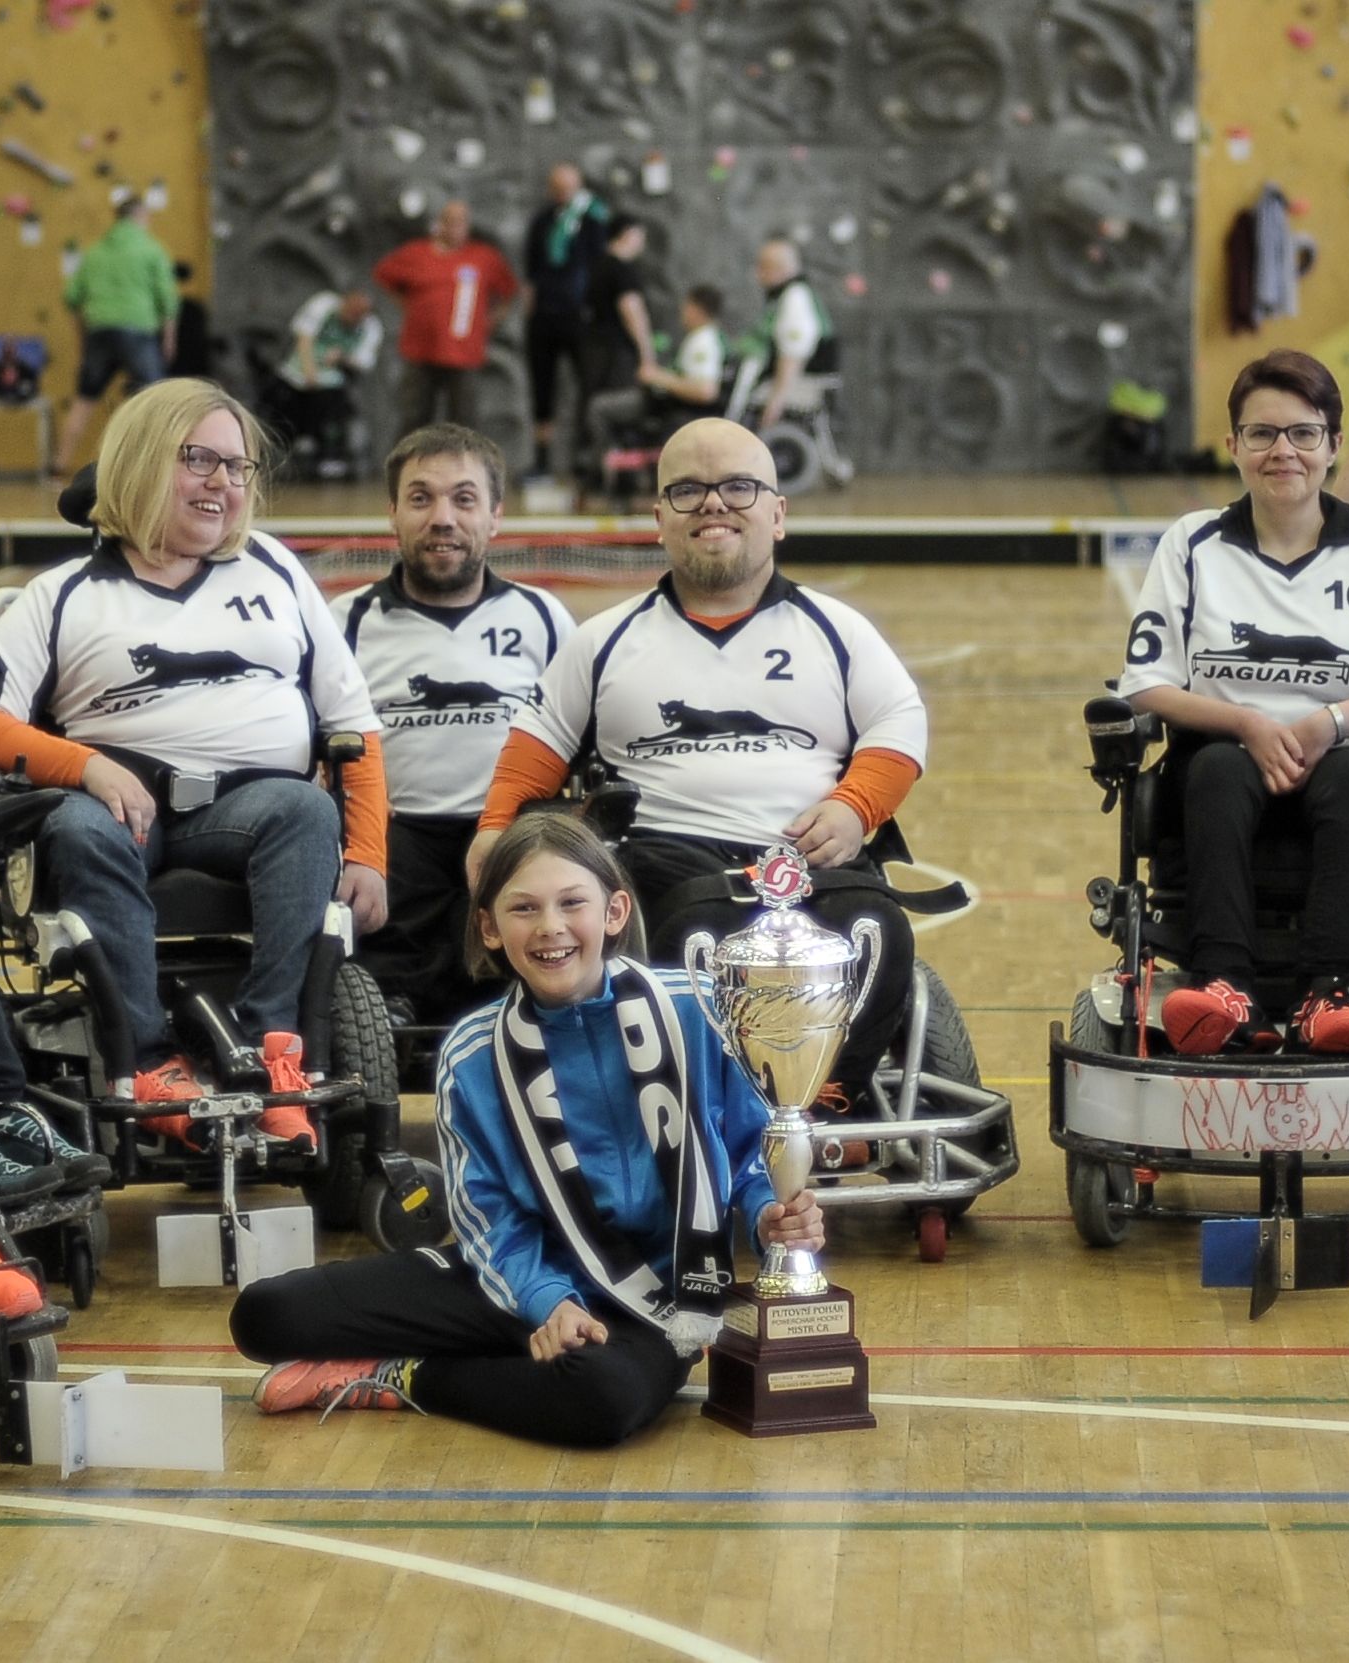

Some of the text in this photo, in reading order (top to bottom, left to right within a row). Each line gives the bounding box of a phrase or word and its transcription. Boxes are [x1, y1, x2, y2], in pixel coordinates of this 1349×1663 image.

[225, 595, 274, 621] 11
[480, 628, 522, 657] 12
[1126, 611, 1166, 665] 6
[764, 649, 794, 681] 2
[1203, 665, 1329, 685] JAGUARS
[388, 711, 496, 729] JAGUARS
[642, 740, 768, 760] JAGUARS
